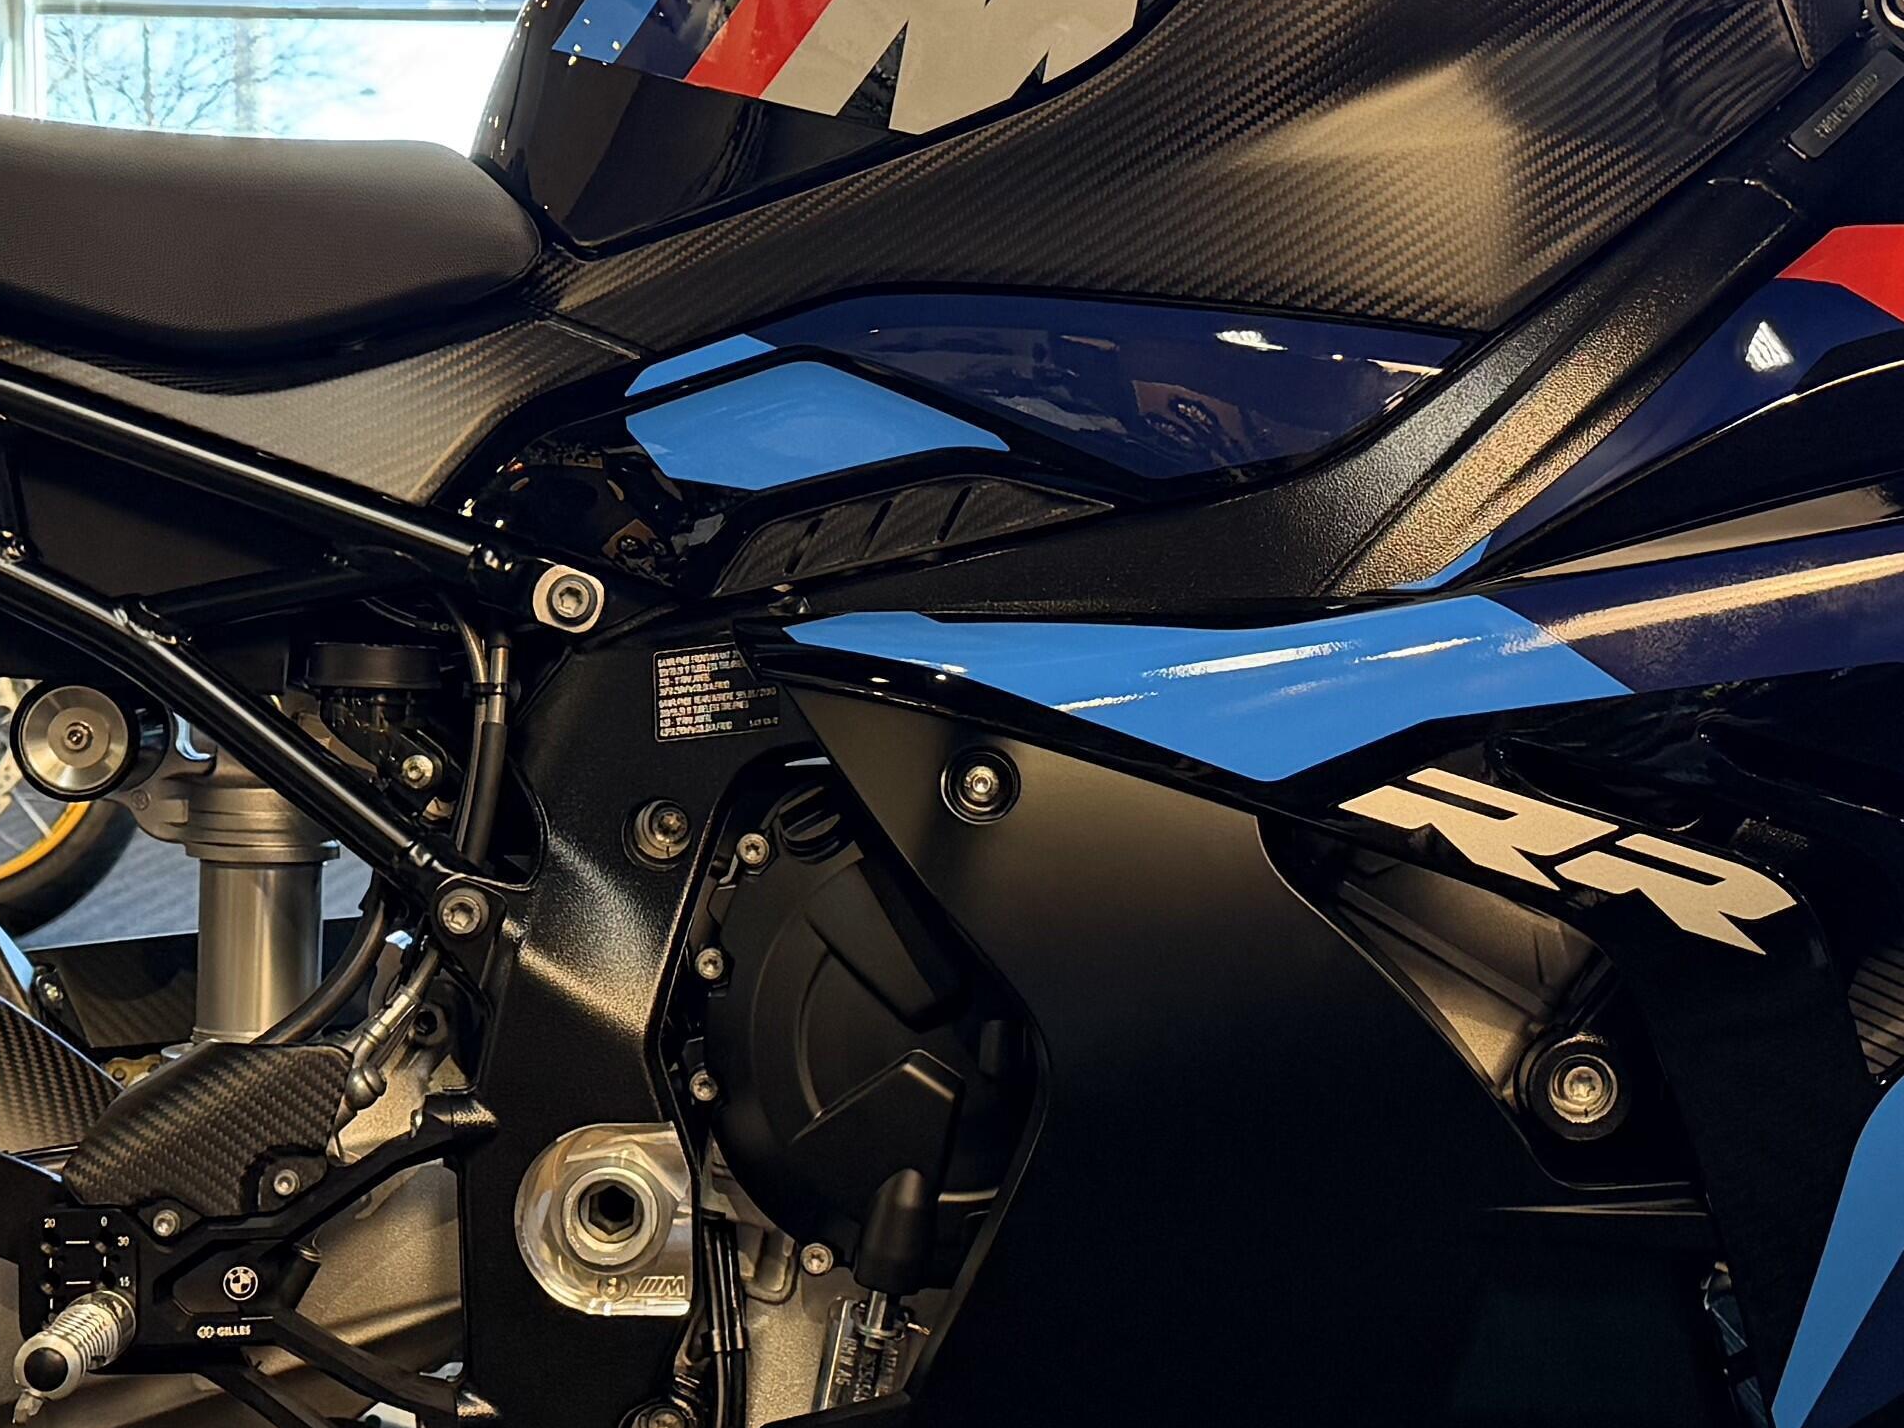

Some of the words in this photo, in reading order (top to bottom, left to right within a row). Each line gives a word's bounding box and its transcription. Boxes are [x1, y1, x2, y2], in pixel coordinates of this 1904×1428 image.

[1339, 767, 1797, 955] RR
[44, 1217, 56, 1229] 20
[117, 1236, 130, 1247] 30
[119, 1276, 131, 1287] 15
[216, 1325, 251, 1337] GILLES
